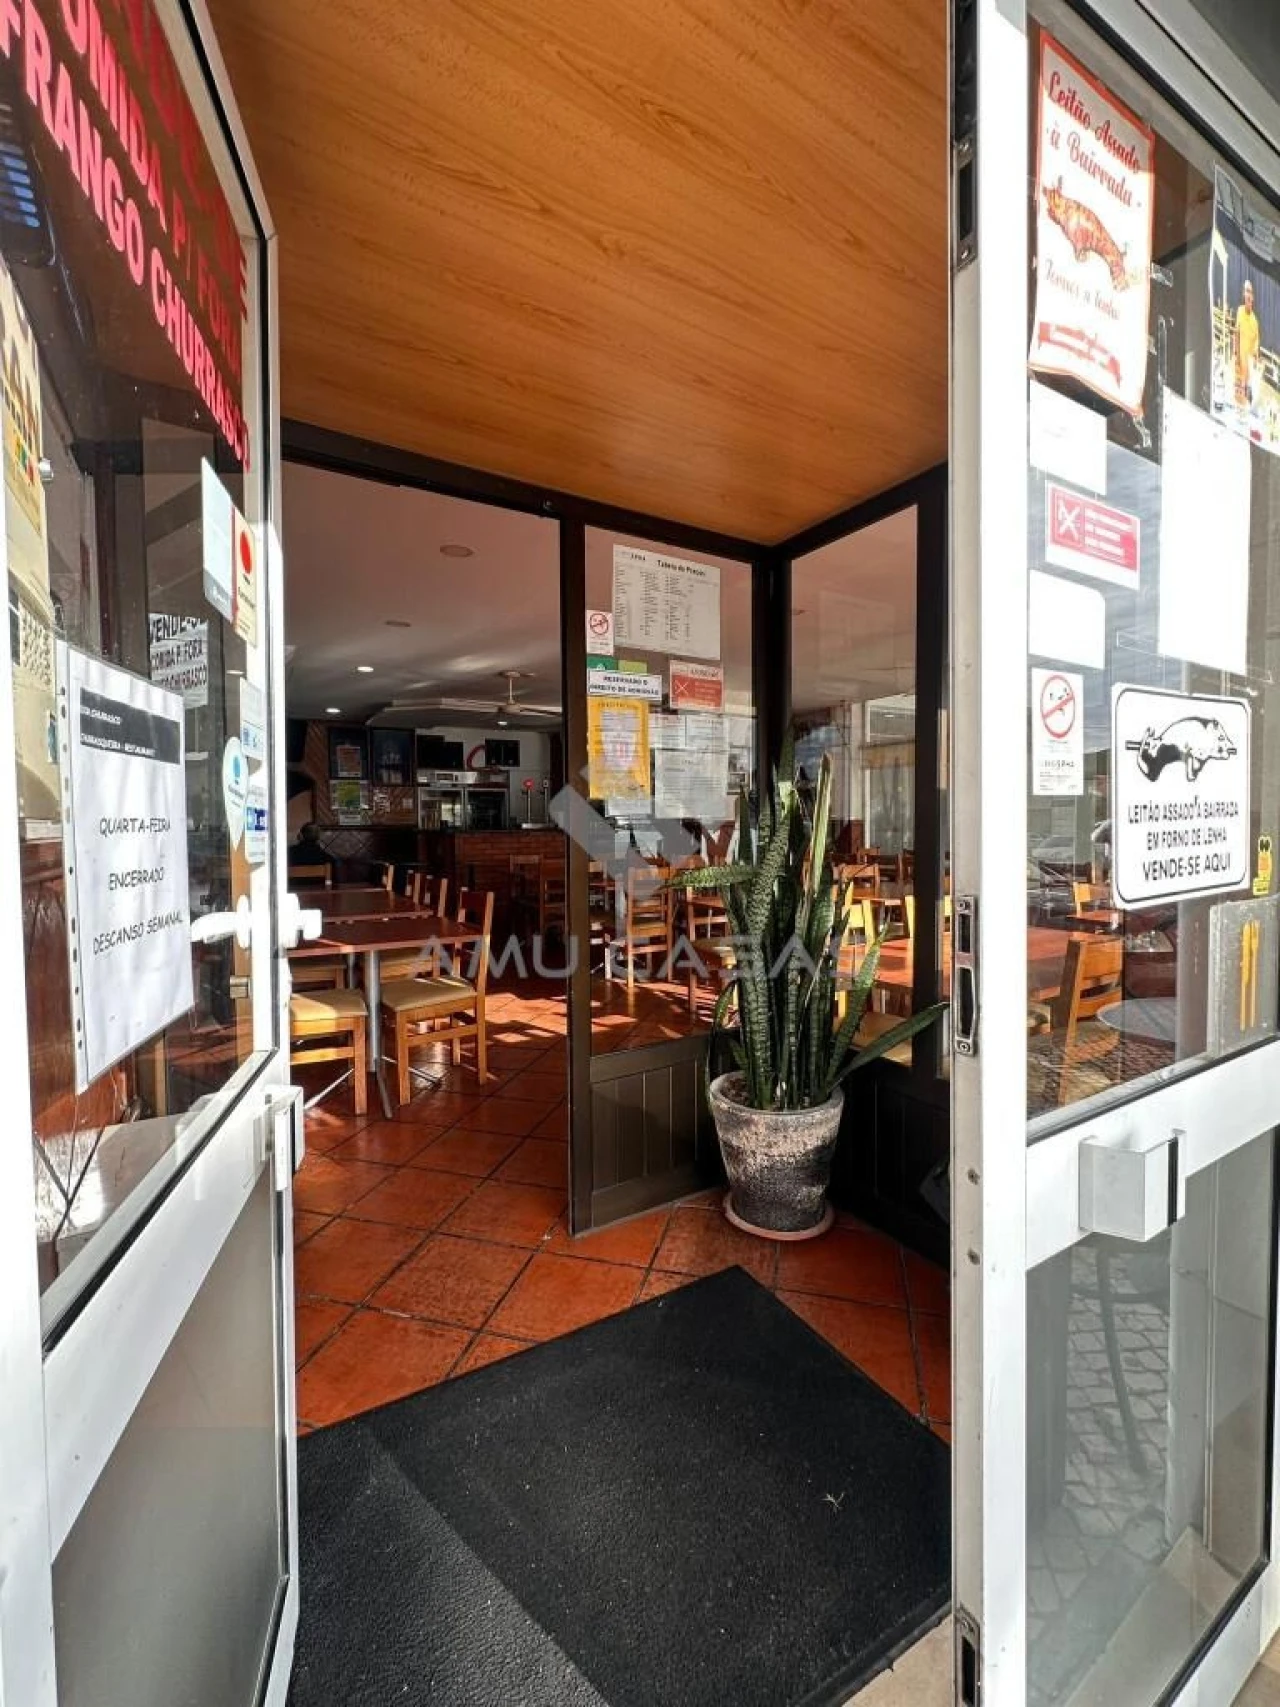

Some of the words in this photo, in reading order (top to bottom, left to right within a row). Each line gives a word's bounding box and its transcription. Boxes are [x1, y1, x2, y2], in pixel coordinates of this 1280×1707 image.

[60, 0, 168, 234] OMIDA
[1049, 71, 1091, 130] Leitão
[1094, 119, 1140, 174] Assado
[1067, 131, 1133, 207] Bairrada
[151, 247, 250, 472] CHURRASCO
[99, 816, 170, 837] QUARTA-FEIRA
[1147, 831, 1159, 850] EM
[1162, 829, 1189, 848] FORNO
[1191, 828, 1201, 846] DE
[1203, 826, 1227, 845] LENHA
[109, 866, 164, 891] ENCERRADO
[1143, 854, 1201, 881] VENDE-SE
[1203, 852, 1230, 872] AQUI
[93, 922, 144, 956] DESCANSO
[146, 910, 183, 935] SEMANAL
